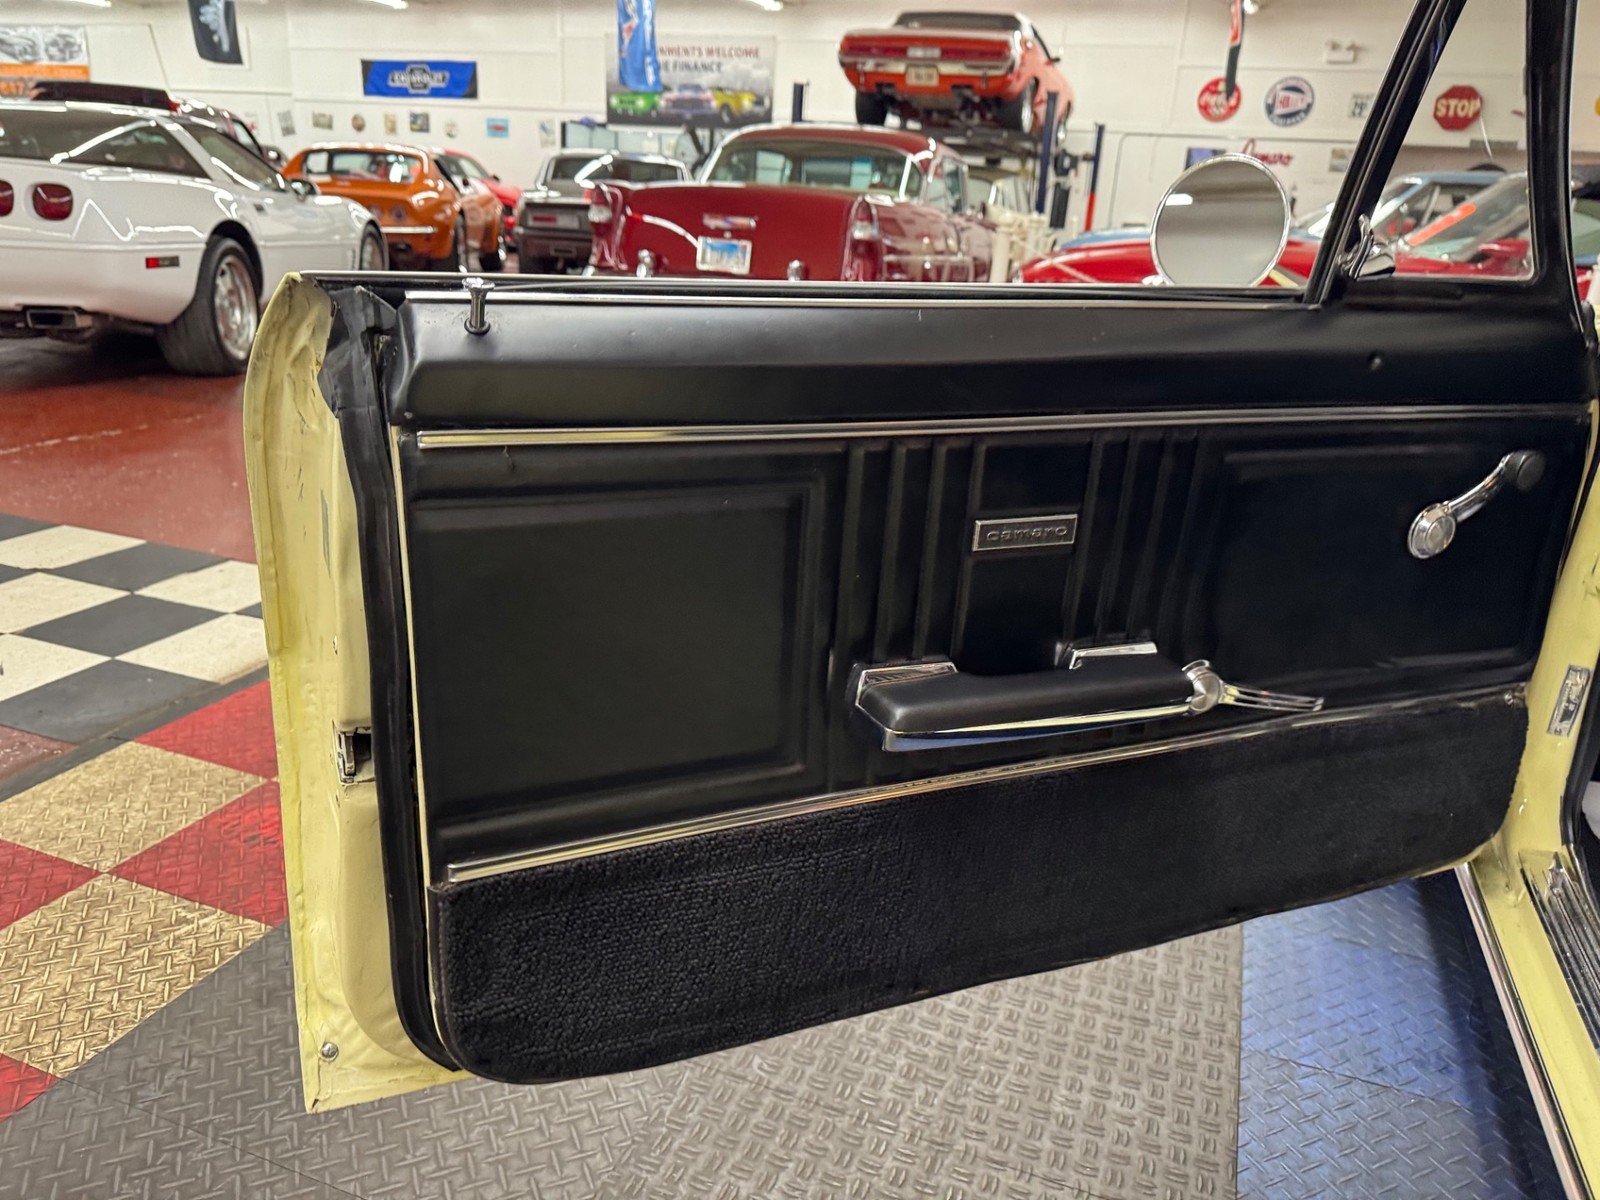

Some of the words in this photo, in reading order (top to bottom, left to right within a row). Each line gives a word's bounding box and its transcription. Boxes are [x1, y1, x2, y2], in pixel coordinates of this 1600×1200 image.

[705, 46, 759, 58] WELCOME
[672, 61, 721, 73] FINANCE
[1436, 99, 1481, 118] STOP
